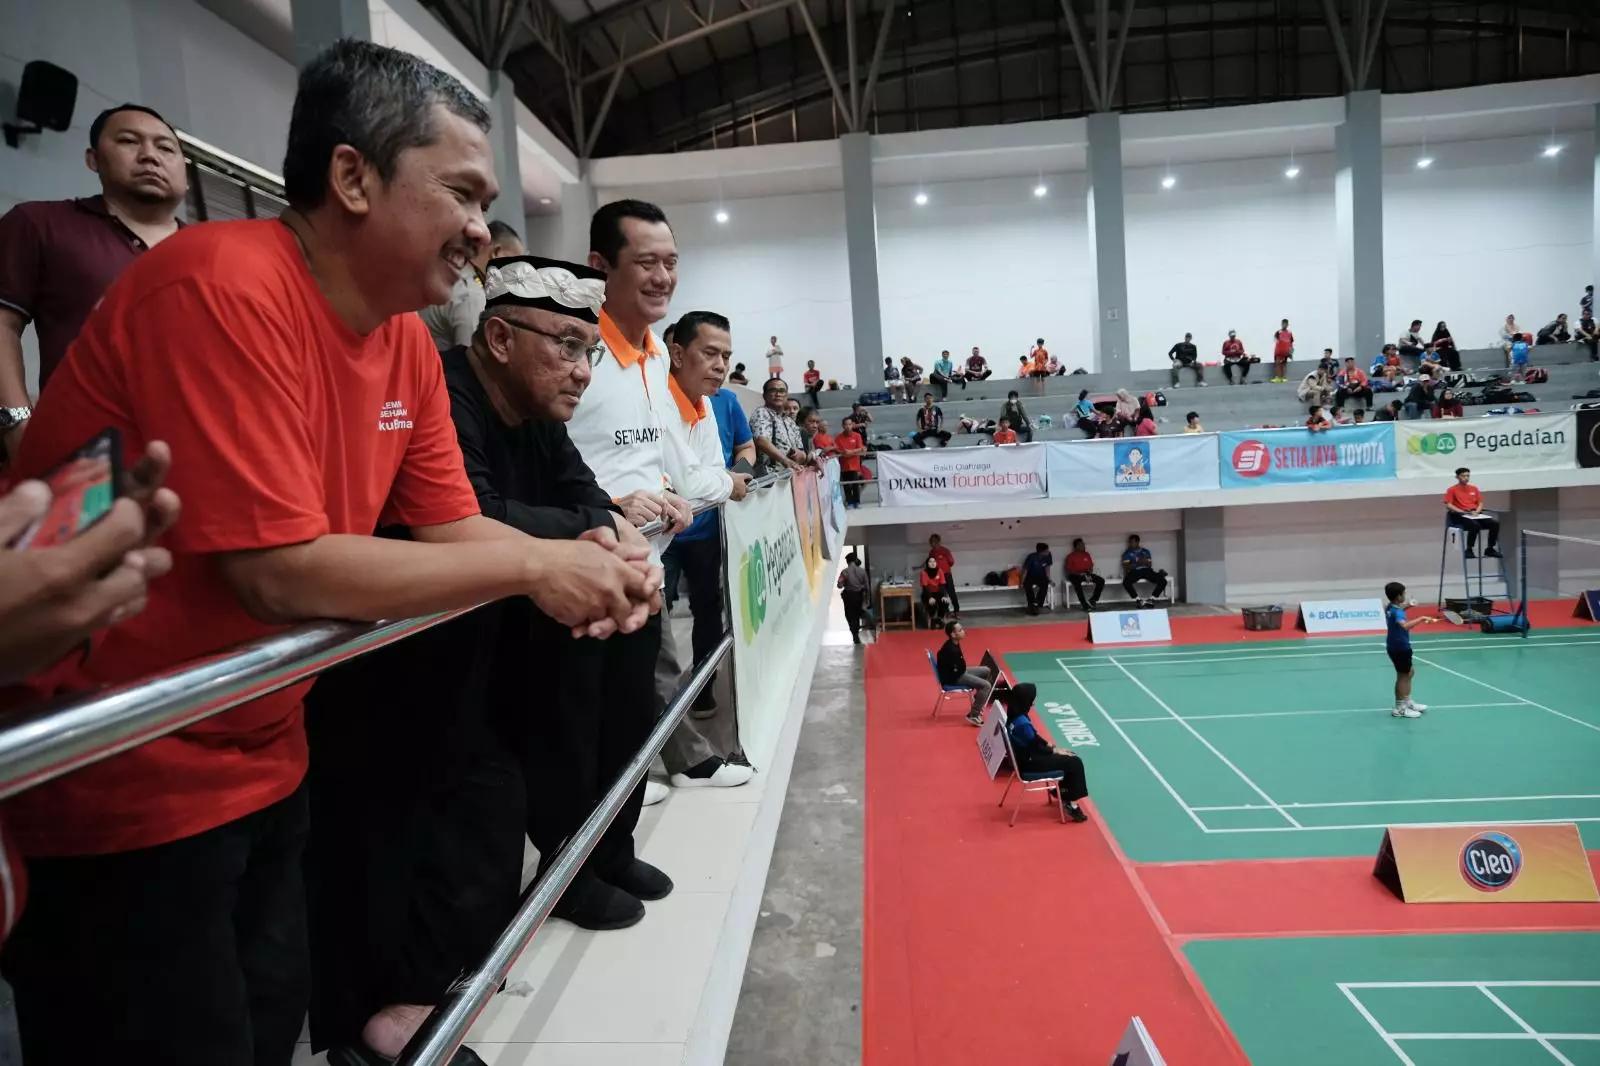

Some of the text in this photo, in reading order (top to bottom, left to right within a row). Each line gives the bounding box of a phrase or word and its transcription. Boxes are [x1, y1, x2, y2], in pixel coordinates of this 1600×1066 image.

[1463, 429, 1565, 452] Pegadaian
[1340, 441, 1385, 467] TOYOTA
[951, 471, 1039, 488] foundation
[1054, 716, 1101, 747] YONEX
[1470, 850, 1513, 875] Cleo
